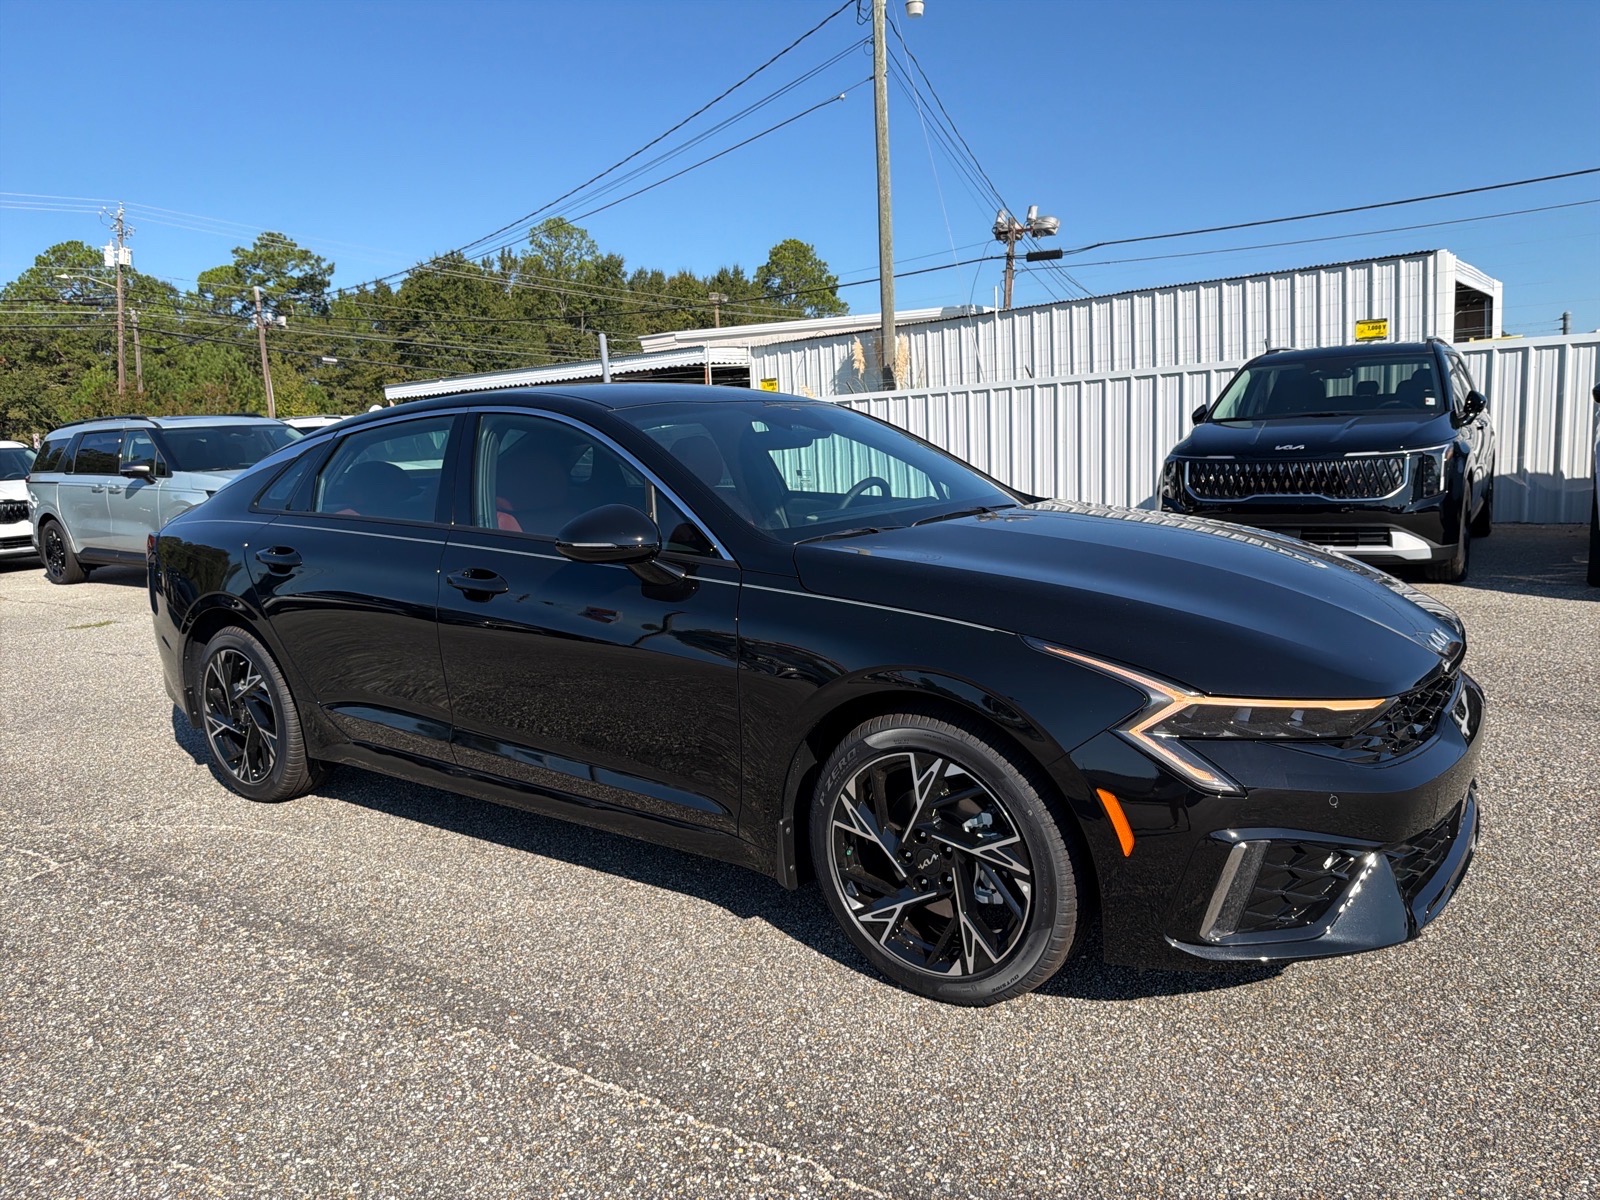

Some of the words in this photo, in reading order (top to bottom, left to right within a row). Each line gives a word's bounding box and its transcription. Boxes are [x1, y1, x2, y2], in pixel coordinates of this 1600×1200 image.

[825, 747, 857, 791] ZERO
[917, 853, 939, 870] KIA
[991, 974, 1020, 993] OUTSIDE
